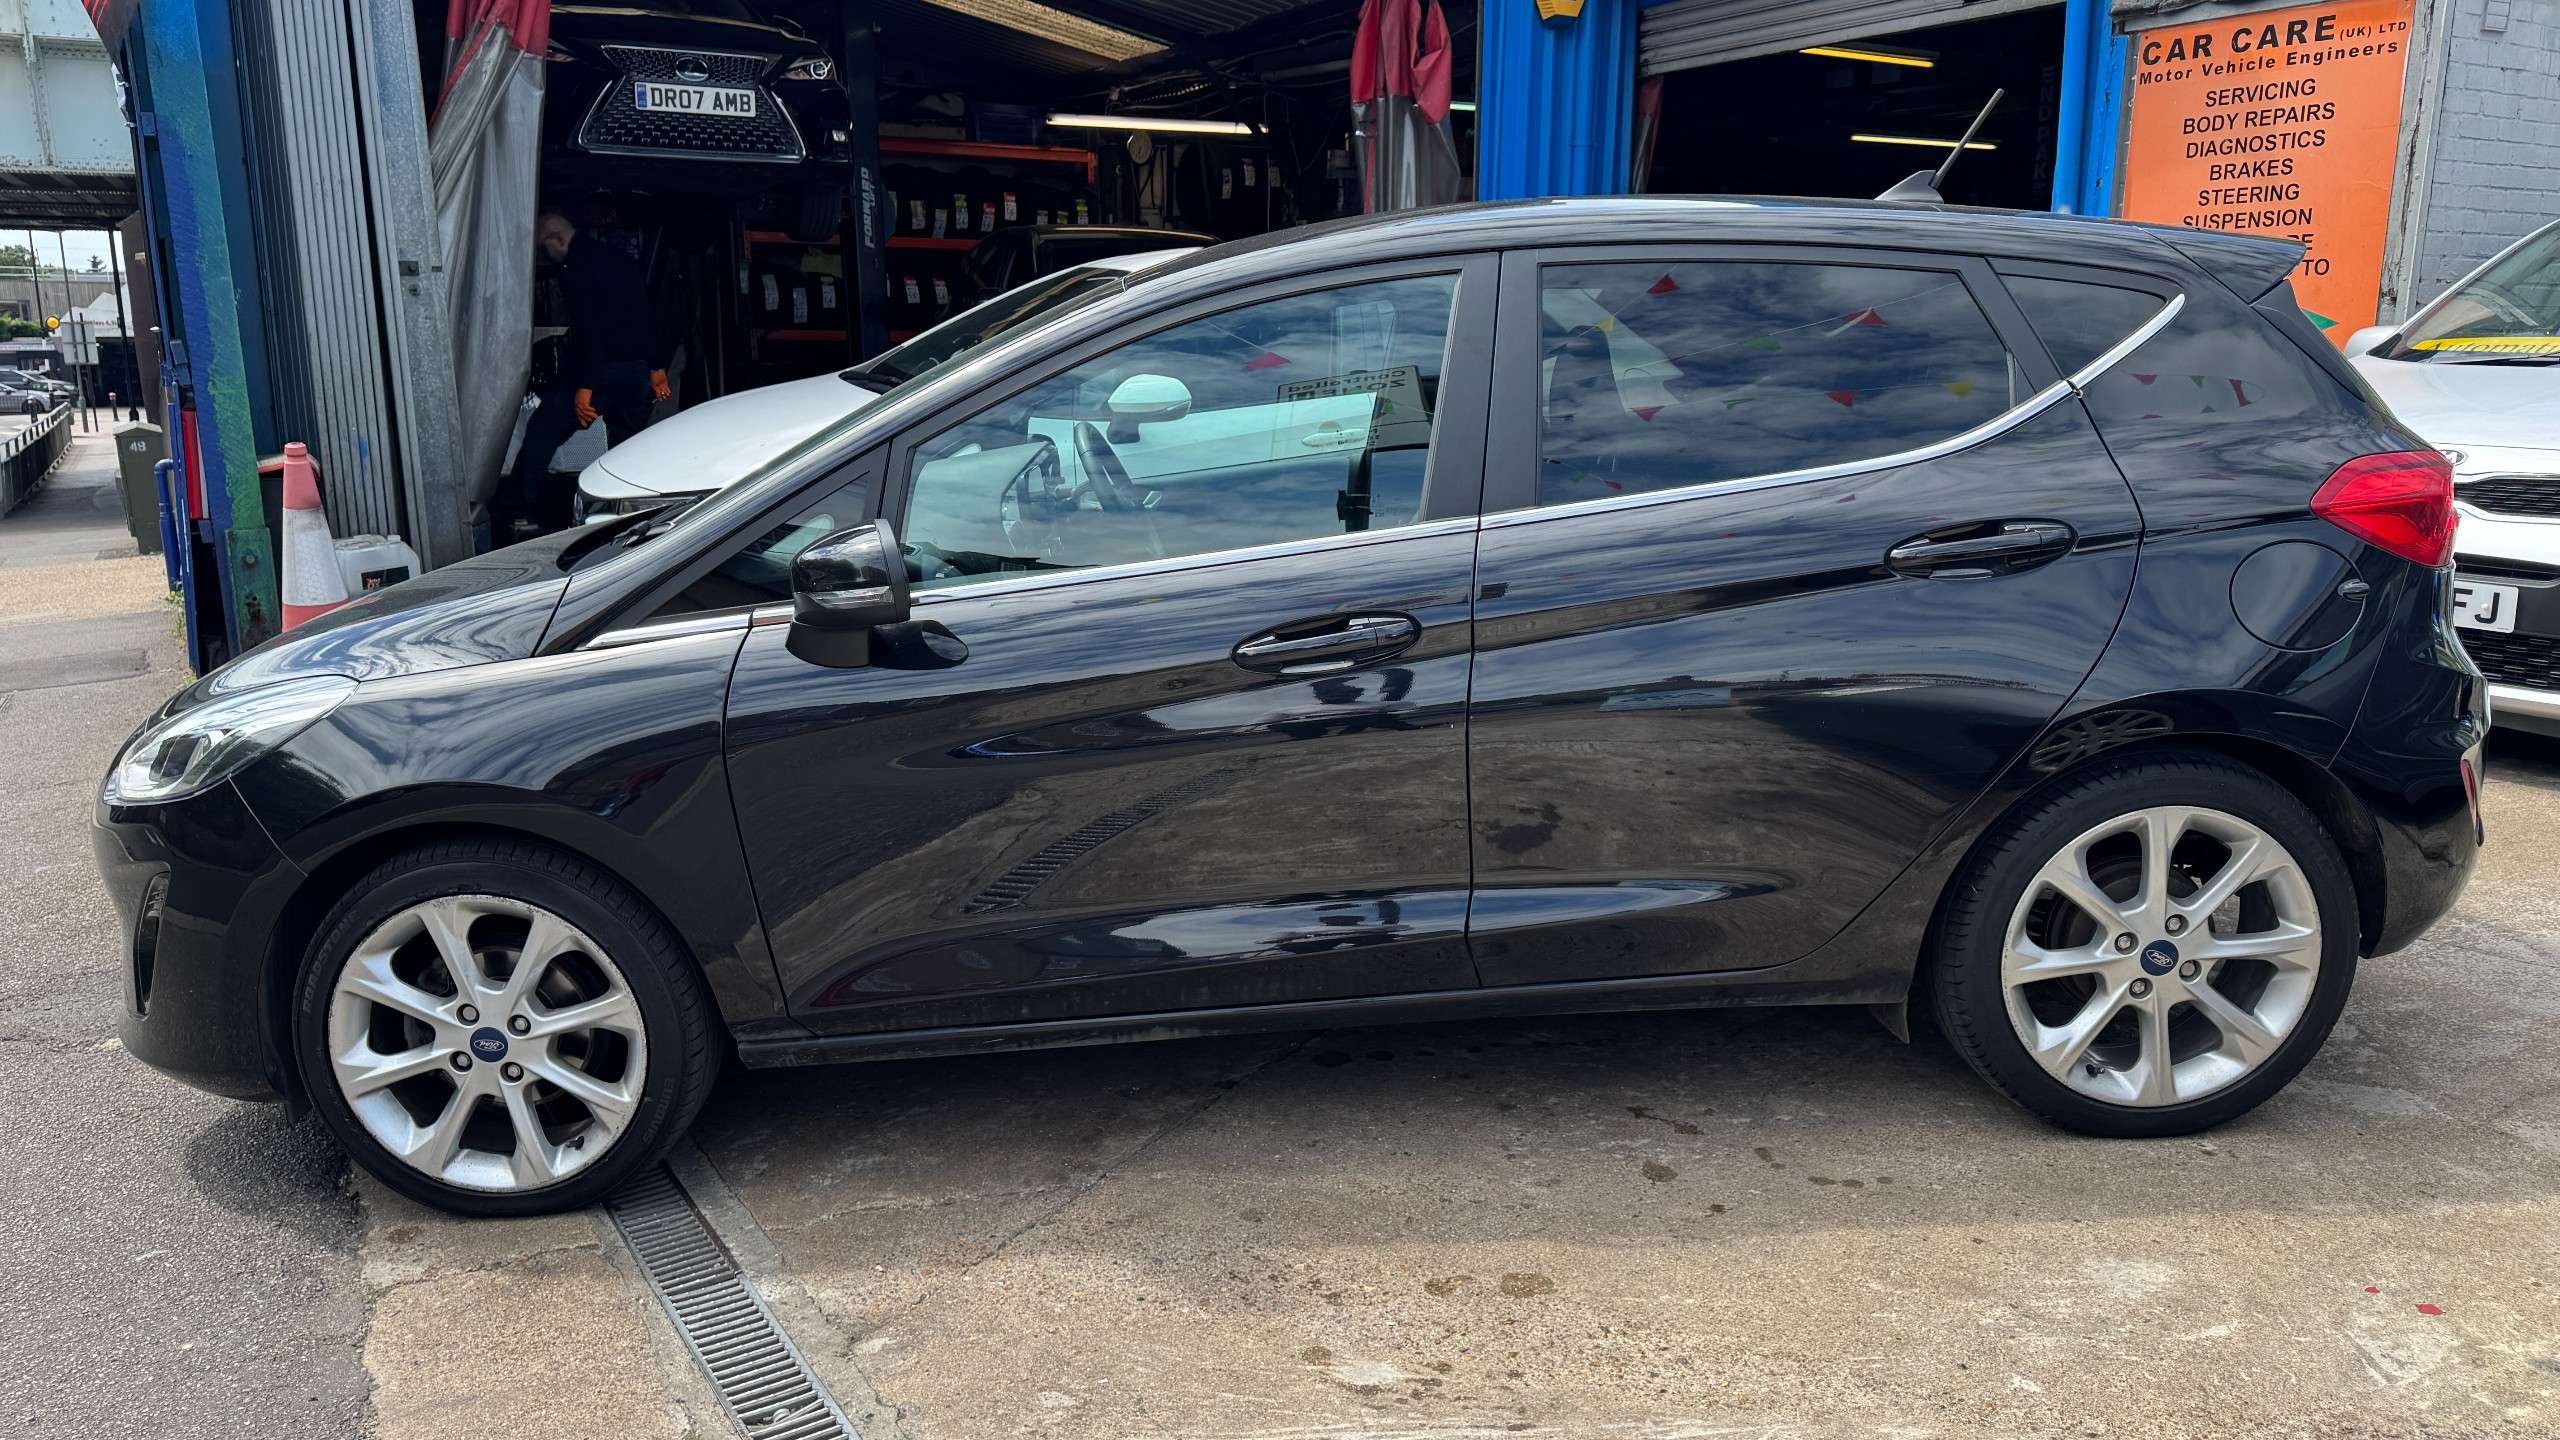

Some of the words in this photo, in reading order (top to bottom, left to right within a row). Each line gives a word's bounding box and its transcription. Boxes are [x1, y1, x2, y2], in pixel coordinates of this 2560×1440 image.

[2143, 34, 2213, 66] CAR
[2231, 15, 2337, 53] CARE
[2339, 26, 2372, 42] (UK)
[2378, 20, 2408, 34] LTD
[2139, 68, 2193, 85] Motor
[2202, 56, 2276, 77] Vehicle
[2286, 41, 2399, 66] Engineers
[650, 87, 704, 109] DR07
[712, 91, 752, 113] AMB
[2205, 78, 2316, 108] SERVICING
[2183, 112, 2239, 135] BODY
[2244, 102, 2336, 128] REPAIRS
[2186, 129, 2326, 159] DIAGNOSTICS
[2209, 158, 2294, 181] BRAKES
[2198, 183, 2300, 207] STEERING
[2183, 208, 2313, 230] SUSPENSION
